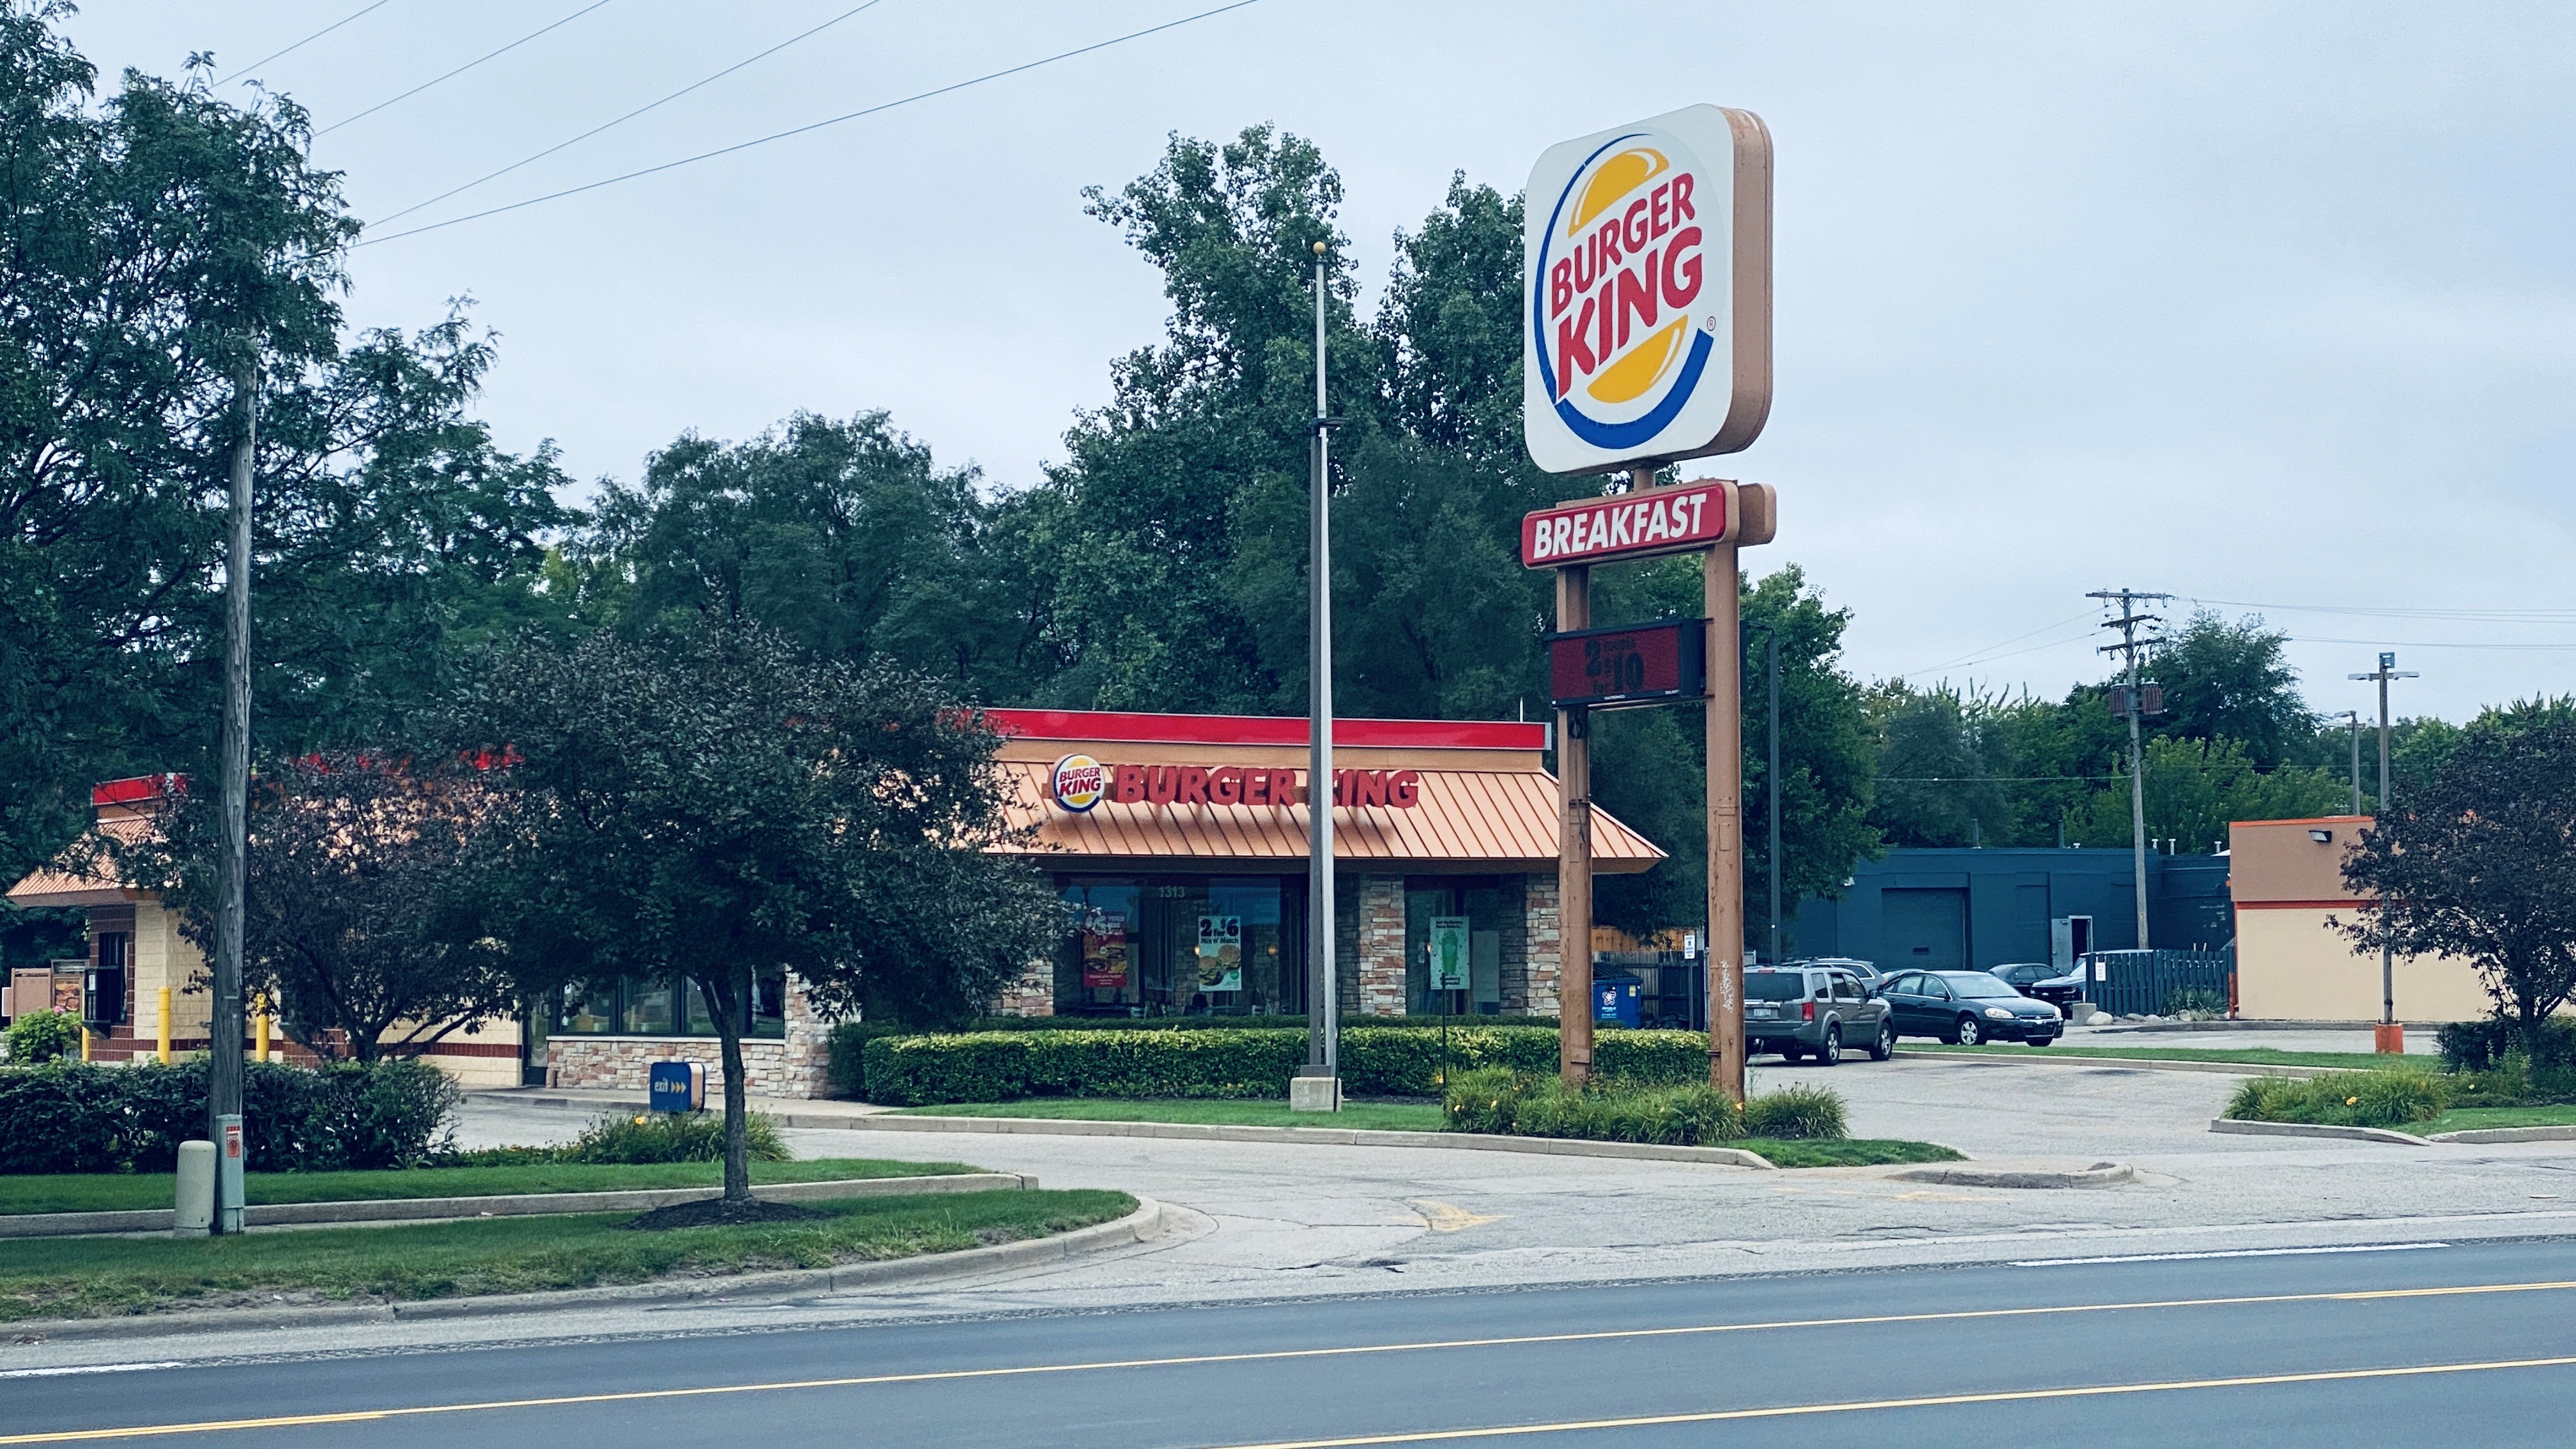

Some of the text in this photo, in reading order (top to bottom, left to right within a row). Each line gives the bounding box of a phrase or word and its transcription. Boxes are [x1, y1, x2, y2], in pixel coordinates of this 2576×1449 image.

[1551, 172, 1695, 321] BURGER
[1558, 227, 1702, 400] KING
[1533, 493, 1707, 559] BREAKFAST
[1585, 640, 1602, 677] 2
[1059, 767, 1100, 783] BURGER
[1059, 778, 1101, 797] KING
[1116, 765, 1419, 809] BURGER ING
[1159, 885, 1185, 898] 1313
[1200, 918, 1239, 937] 2 for $6
[654, 1077, 668, 1092] exit
